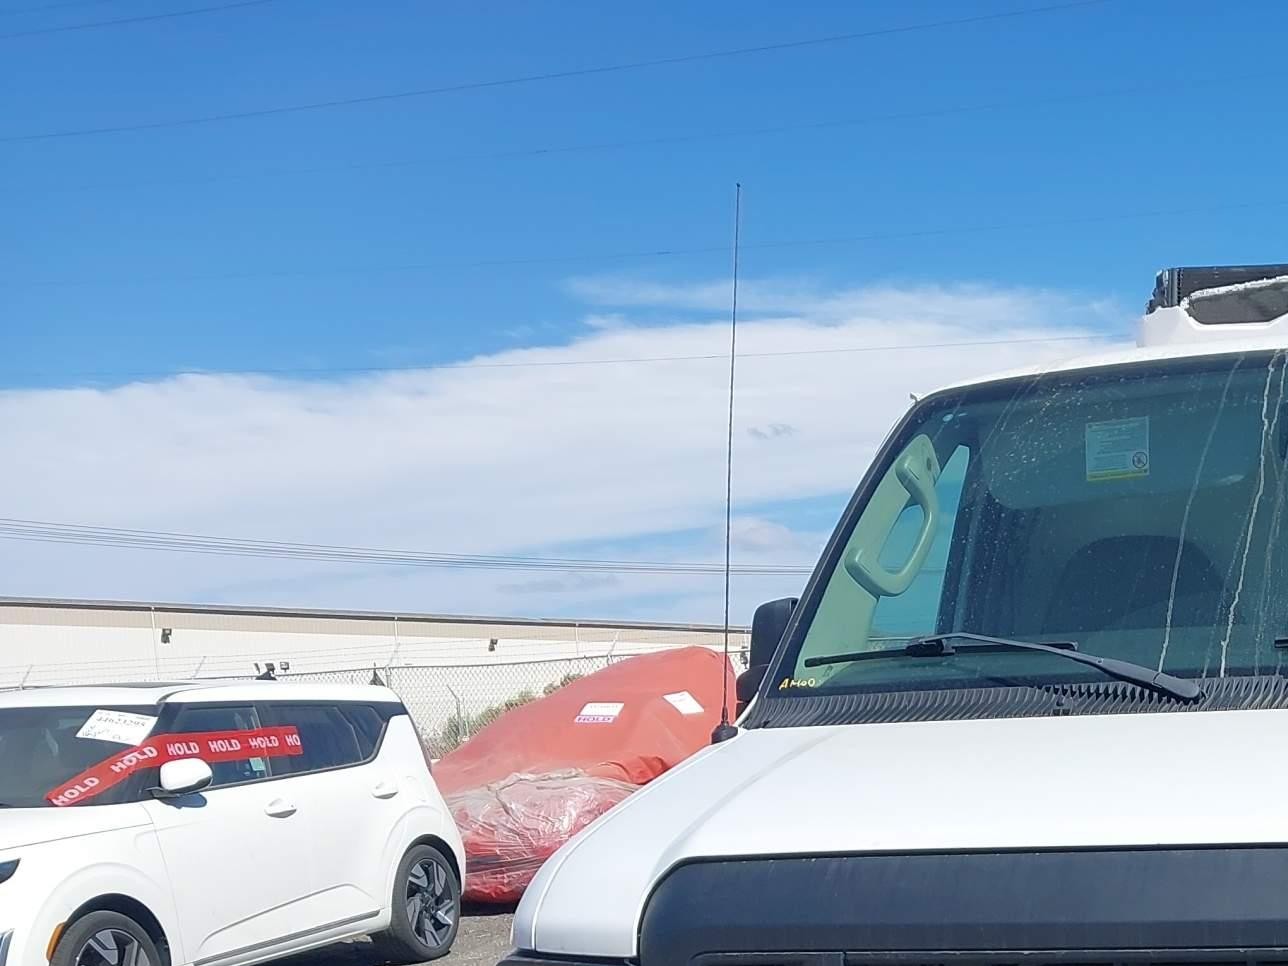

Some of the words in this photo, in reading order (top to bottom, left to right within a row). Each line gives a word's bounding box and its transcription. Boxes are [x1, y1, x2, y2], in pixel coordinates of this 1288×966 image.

[51, 776, 100, 807] HOLD
[110, 746, 158, 773] HOLD
[166, 742, 200, 756] HOLD
[208, 738, 241, 753] HOLD
[249, 735, 279, 749] HOLD
